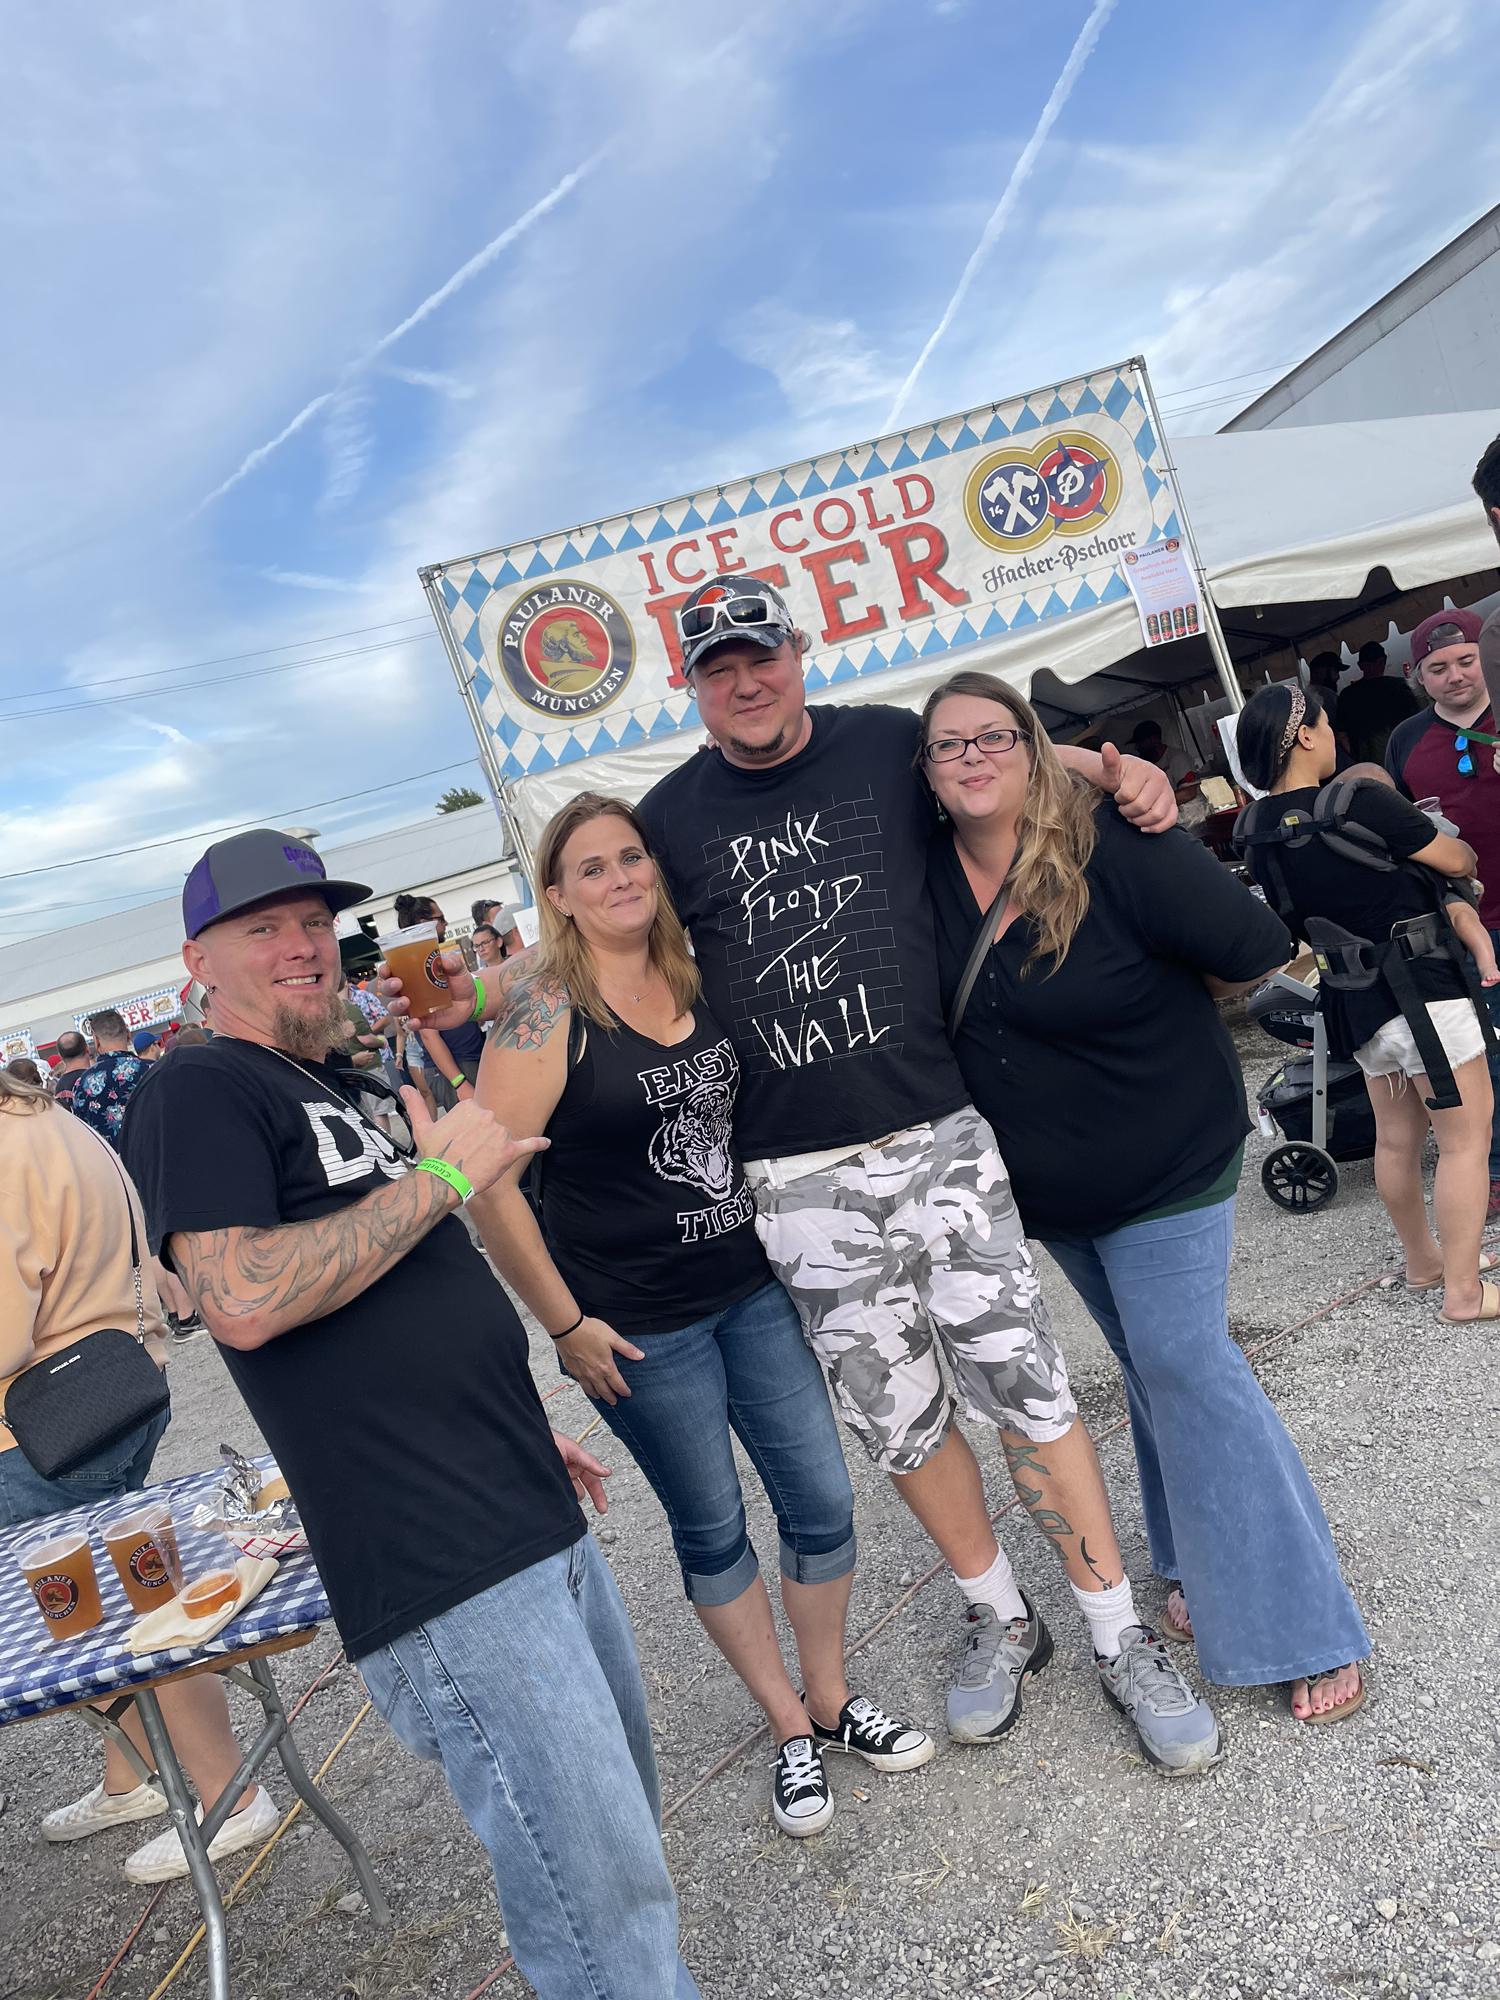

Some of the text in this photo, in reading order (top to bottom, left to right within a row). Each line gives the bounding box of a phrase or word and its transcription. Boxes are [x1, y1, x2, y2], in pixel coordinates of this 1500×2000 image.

[638, 473, 935, 596] ICE COLD
[988, 493, 1041, 518] 14 17
[982, 531, 1136, 593] Hacker-Pschorr
[504, 586, 614, 649] PAULANER
[644, 521, 971, 689] ER
[531, 667, 624, 711] MÜNCHEN
[729, 812, 829, 881] PINK
[741, 868, 862, 945] FLOYD
[756, 924, 846, 1003] THE
[122, 1000, 148, 1014] COLD
[752, 984, 890, 1070] WALL
[637, 1038, 740, 1104] EASY
[677, 1177, 754, 1243] TIGE
[130, 1541, 154, 1566] PAULA
[140, 1575, 169, 1587] MÜNCH
